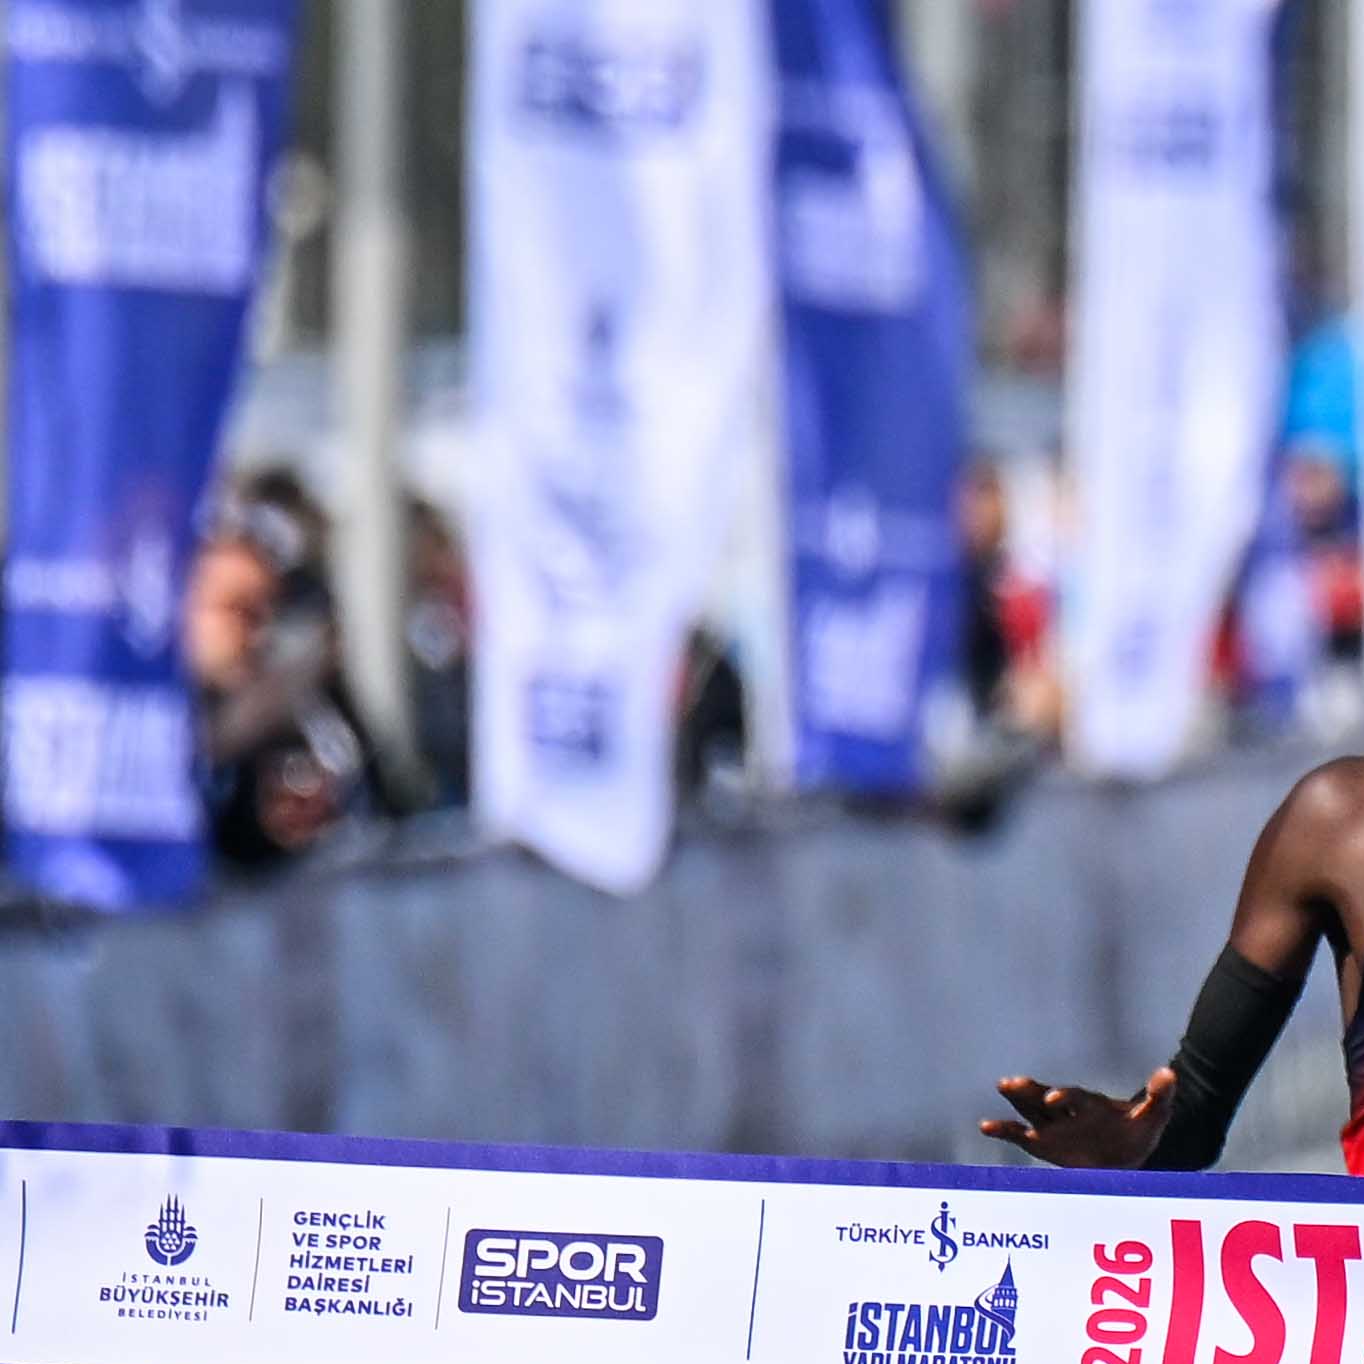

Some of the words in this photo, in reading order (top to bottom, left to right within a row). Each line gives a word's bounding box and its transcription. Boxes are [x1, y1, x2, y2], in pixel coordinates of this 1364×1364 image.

[293, 1210, 386, 1231] GENÇLİK
[292, 1232, 320, 1248] VE
[325, 1234, 382, 1251] SPOR
[836, 1222, 926, 1245] TÜRKİYE
[962, 1231, 1049, 1250] BANKASI
[289, 1250, 413, 1274] HİZMETLERİ
[474, 1237, 648, 1283] SPOR
[122, 1271, 212, 1287] İSTANBUL
[287, 1272, 370, 1293] DAİRESİ
[99, 1285, 230, 1308] BÜYÜKŞEHİR
[285, 1296, 413, 1317] BAŞKANLIĞI
[118, 1308, 208, 1321] BELEDİYESİ
